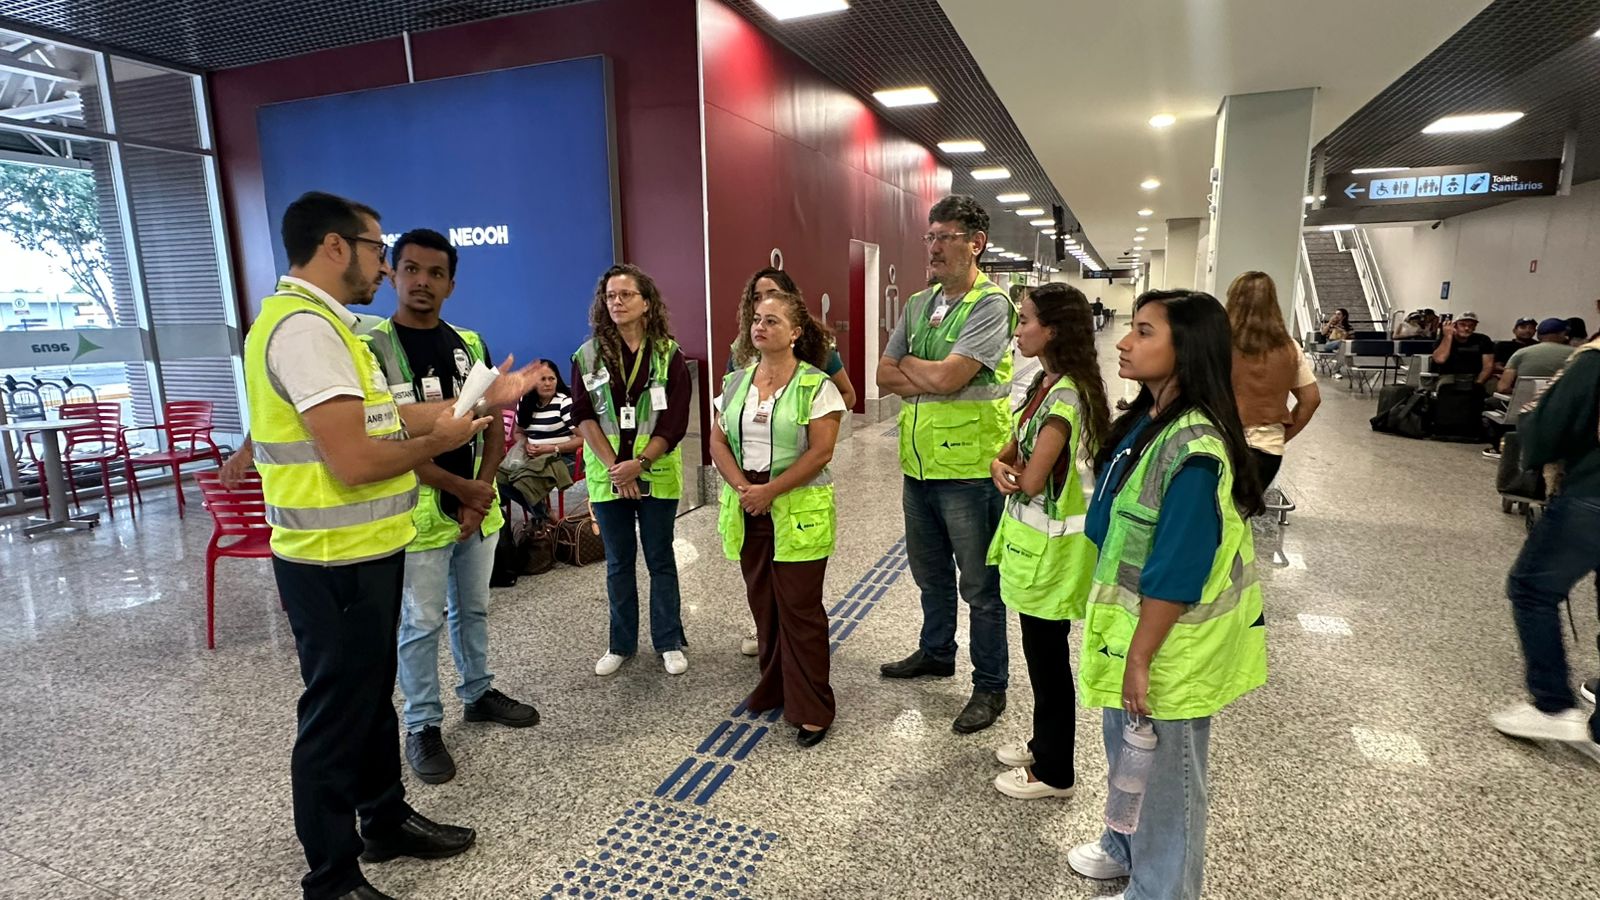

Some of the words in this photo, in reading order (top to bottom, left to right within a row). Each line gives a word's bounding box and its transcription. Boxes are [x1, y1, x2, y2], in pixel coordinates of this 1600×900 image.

[1492, 175, 1518, 183] Toilets
[1490, 180, 1543, 193] Sanitários
[448, 225, 509, 247] NEOOH
